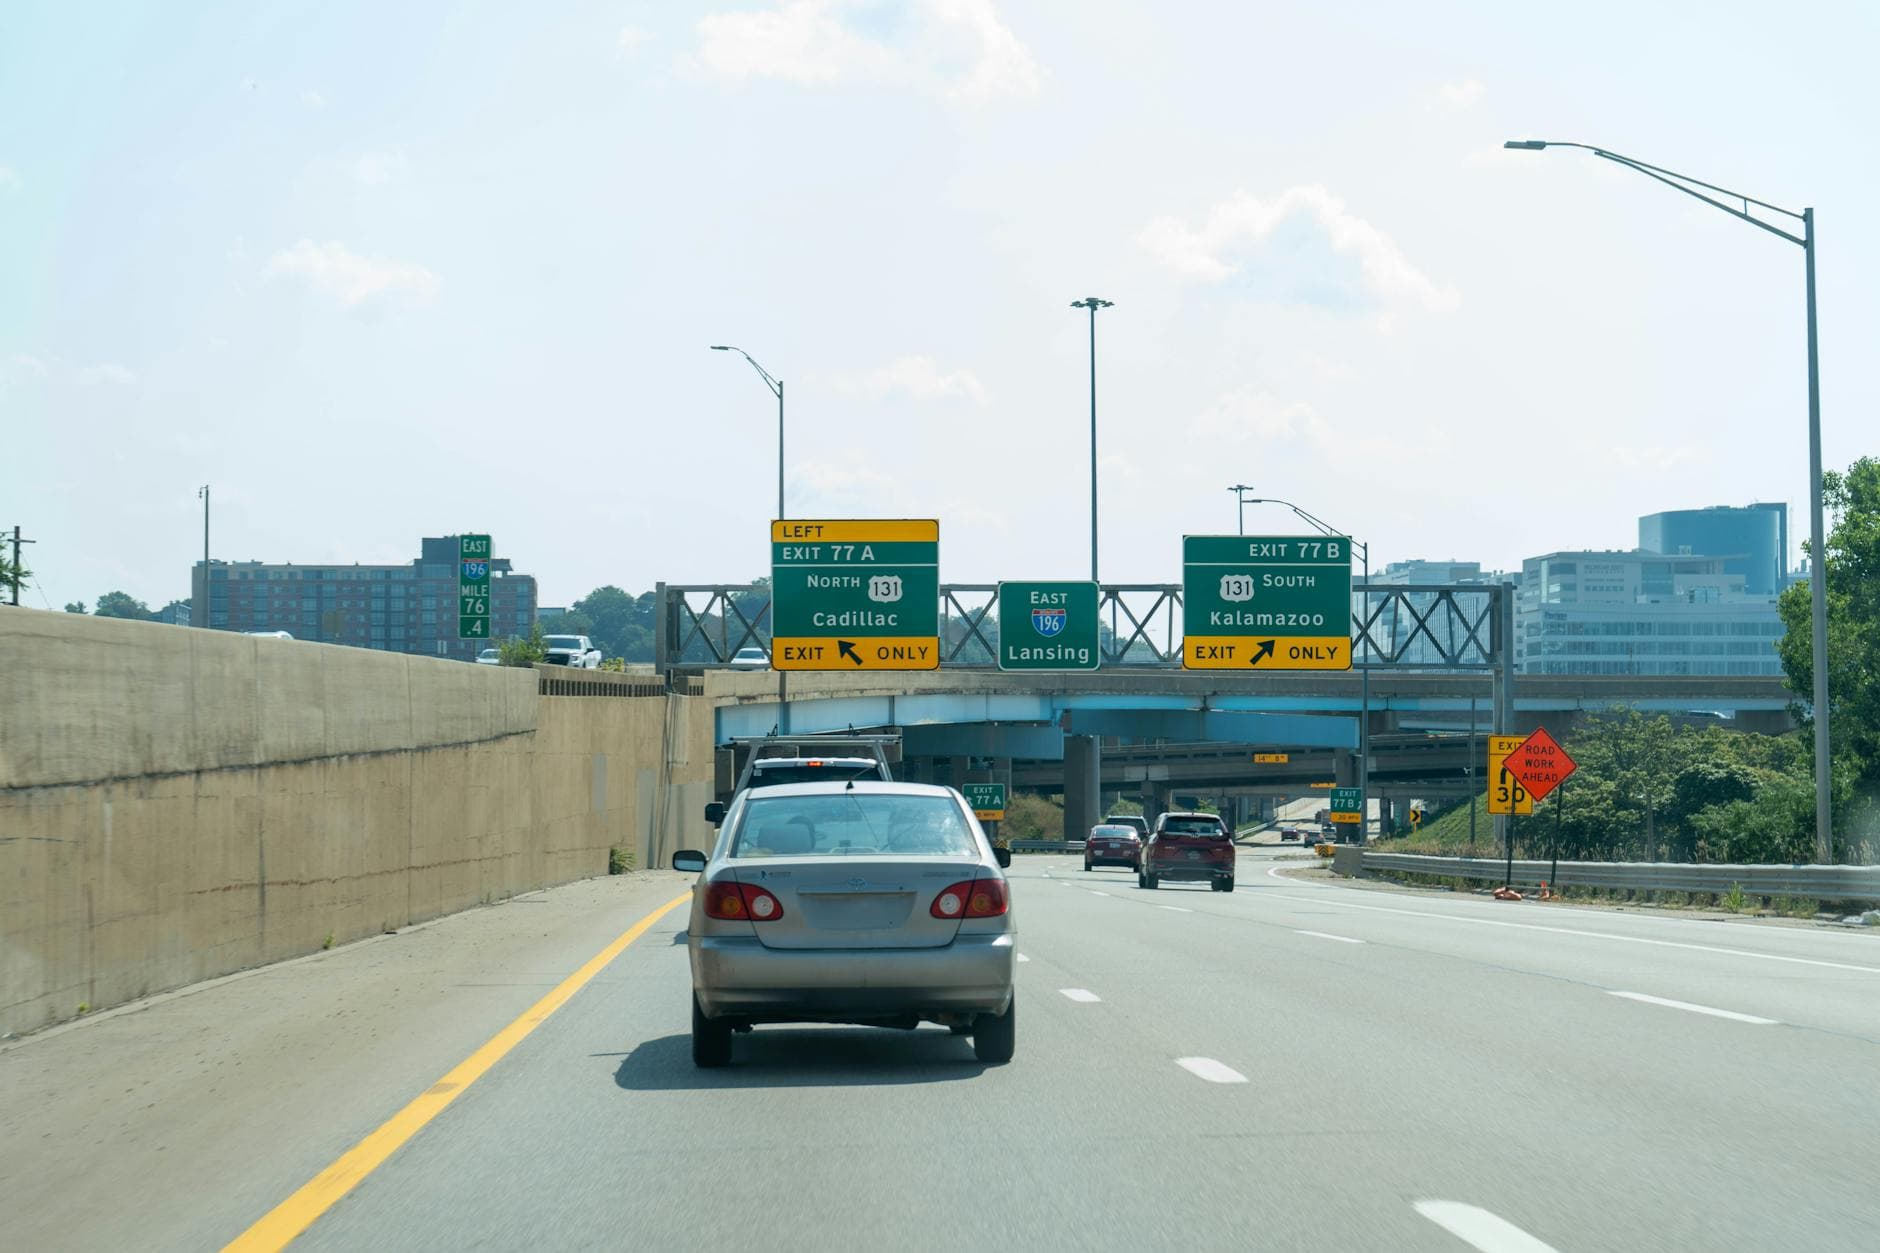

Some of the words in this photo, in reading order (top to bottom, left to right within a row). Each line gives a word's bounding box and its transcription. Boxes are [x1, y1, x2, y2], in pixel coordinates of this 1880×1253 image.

[783, 525, 824, 538] LEFT
[462, 539, 487, 553] EAST
[783, 547, 821, 560] EXIT
[831, 545, 855, 561] 77
[1249, 543, 1288, 557] EXIT
[1297, 542, 1322, 558] 77
[464, 563, 485, 575] 196
[461, 585, 488, 597] MILE
[807, 575, 860, 588] NORTH
[873, 581, 899, 597] 131
[1225, 580, 1250, 596] 131
[1263, 574, 1315, 587] SOUTH
[1030, 591, 1068, 604] EAST
[465, 598, 485, 614] 76
[813, 611, 898, 627] Cadillac
[1039, 616, 1059, 631] 196
[1210, 610, 1324, 626] Kalamazoo
[784, 647, 824, 660] EXIT
[877, 646, 928, 660] ONLY
[1009, 644, 1089, 664] Lansing
[1195, 646, 1236, 659] EXIT
[1289, 646, 1338, 660] ONLY
[1498, 742, 1523, 751] EXI
[1526, 745, 1555, 755] ROAD
[1525, 759, 1554, 769] WORK
[1522, 772, 1558, 783] AHEAD
[973, 786, 993, 794] EXIT
